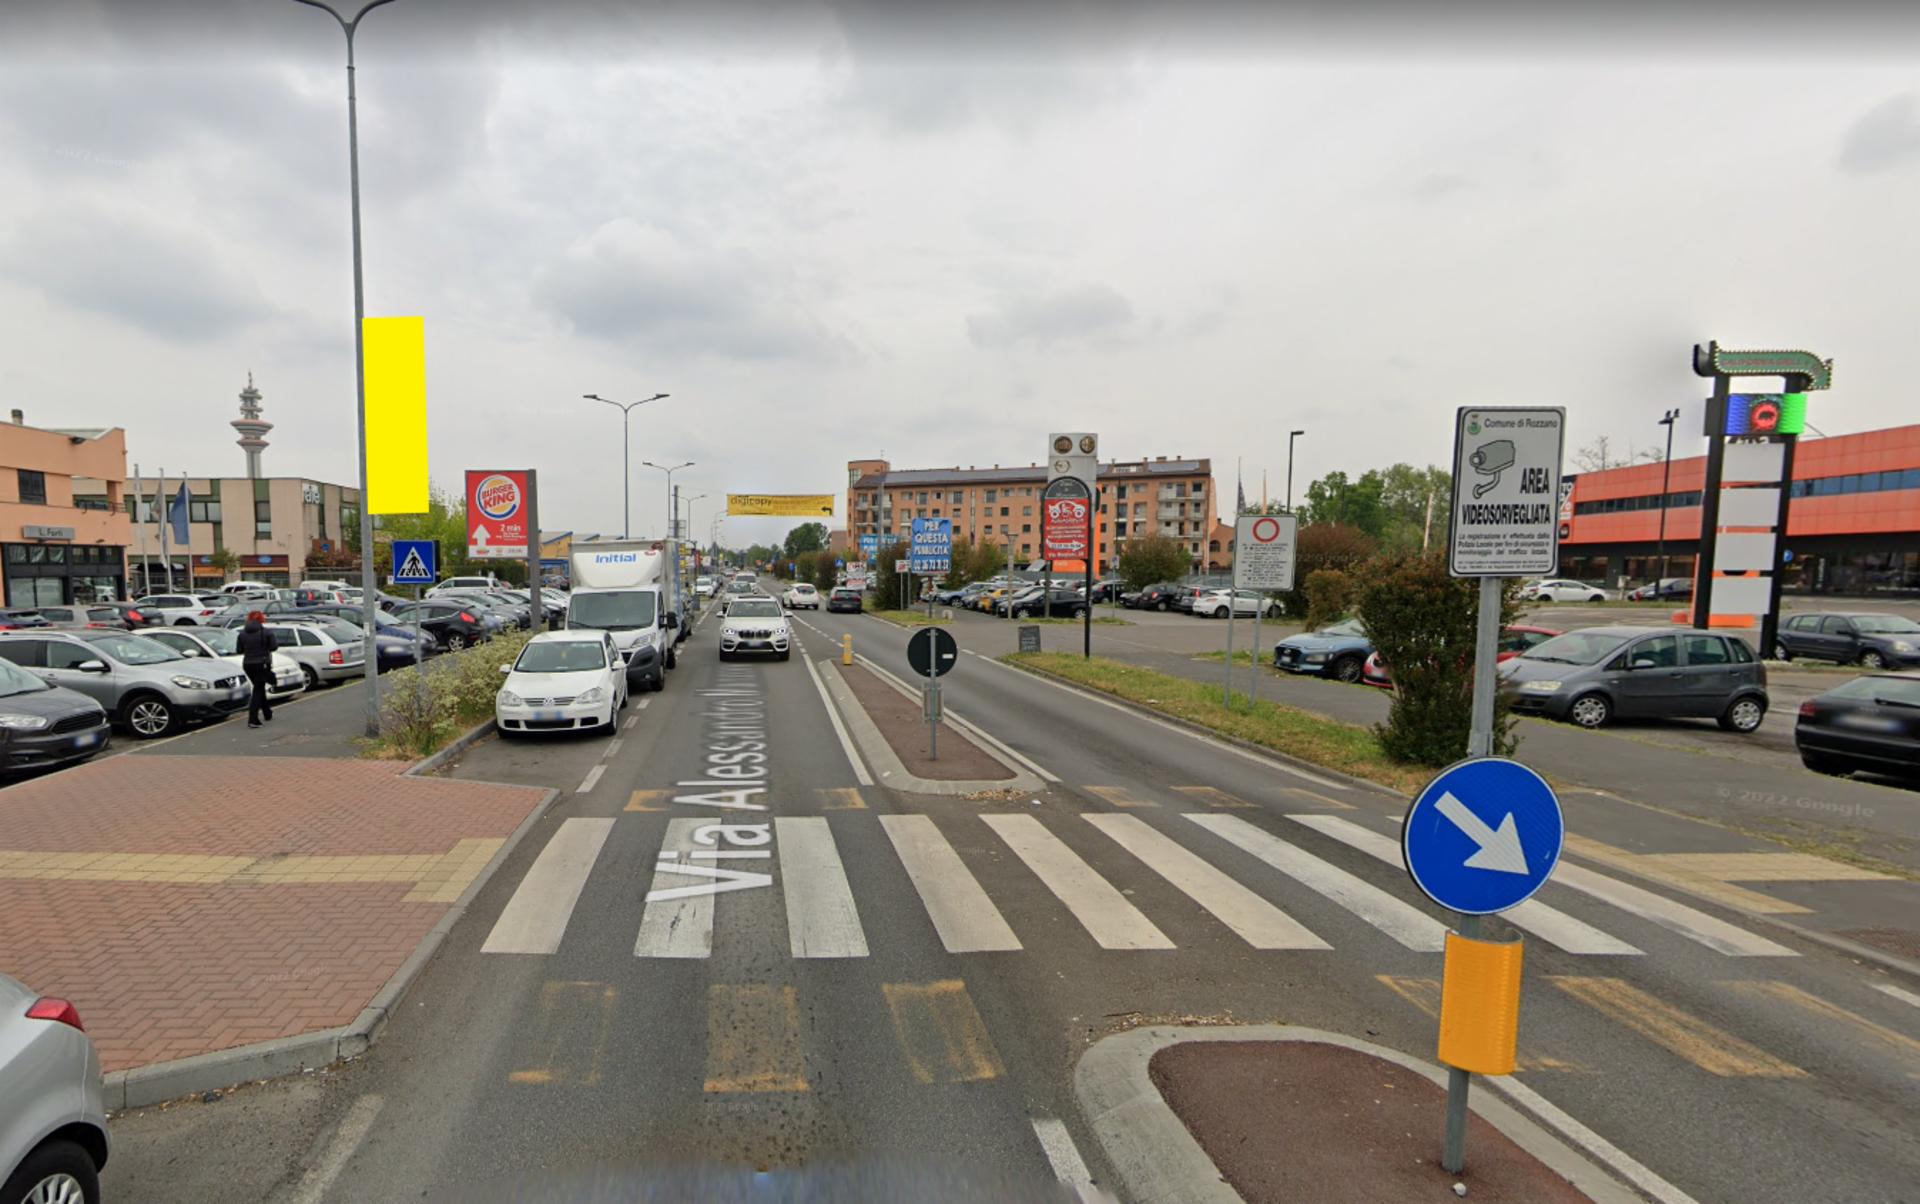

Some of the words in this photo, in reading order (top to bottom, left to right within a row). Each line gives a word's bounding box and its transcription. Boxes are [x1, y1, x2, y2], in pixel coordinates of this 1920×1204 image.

[1484, 418, 1516, 428] Comune
[1517, 419, 1525, 428] di
[1526, 419, 1558, 428] Rozzano
[1520, 468, 1549, 494] AREA
[482, 483, 514, 500] BURGER
[483, 491, 515, 509] KING
[1462, 504, 1551, 525] VIDEOSORVEGLIATA
[500, 524, 505, 532] 2
[924, 521, 939, 531] PER
[915, 533, 948, 544] QUESTA
[595, 553, 637, 564] Initial
